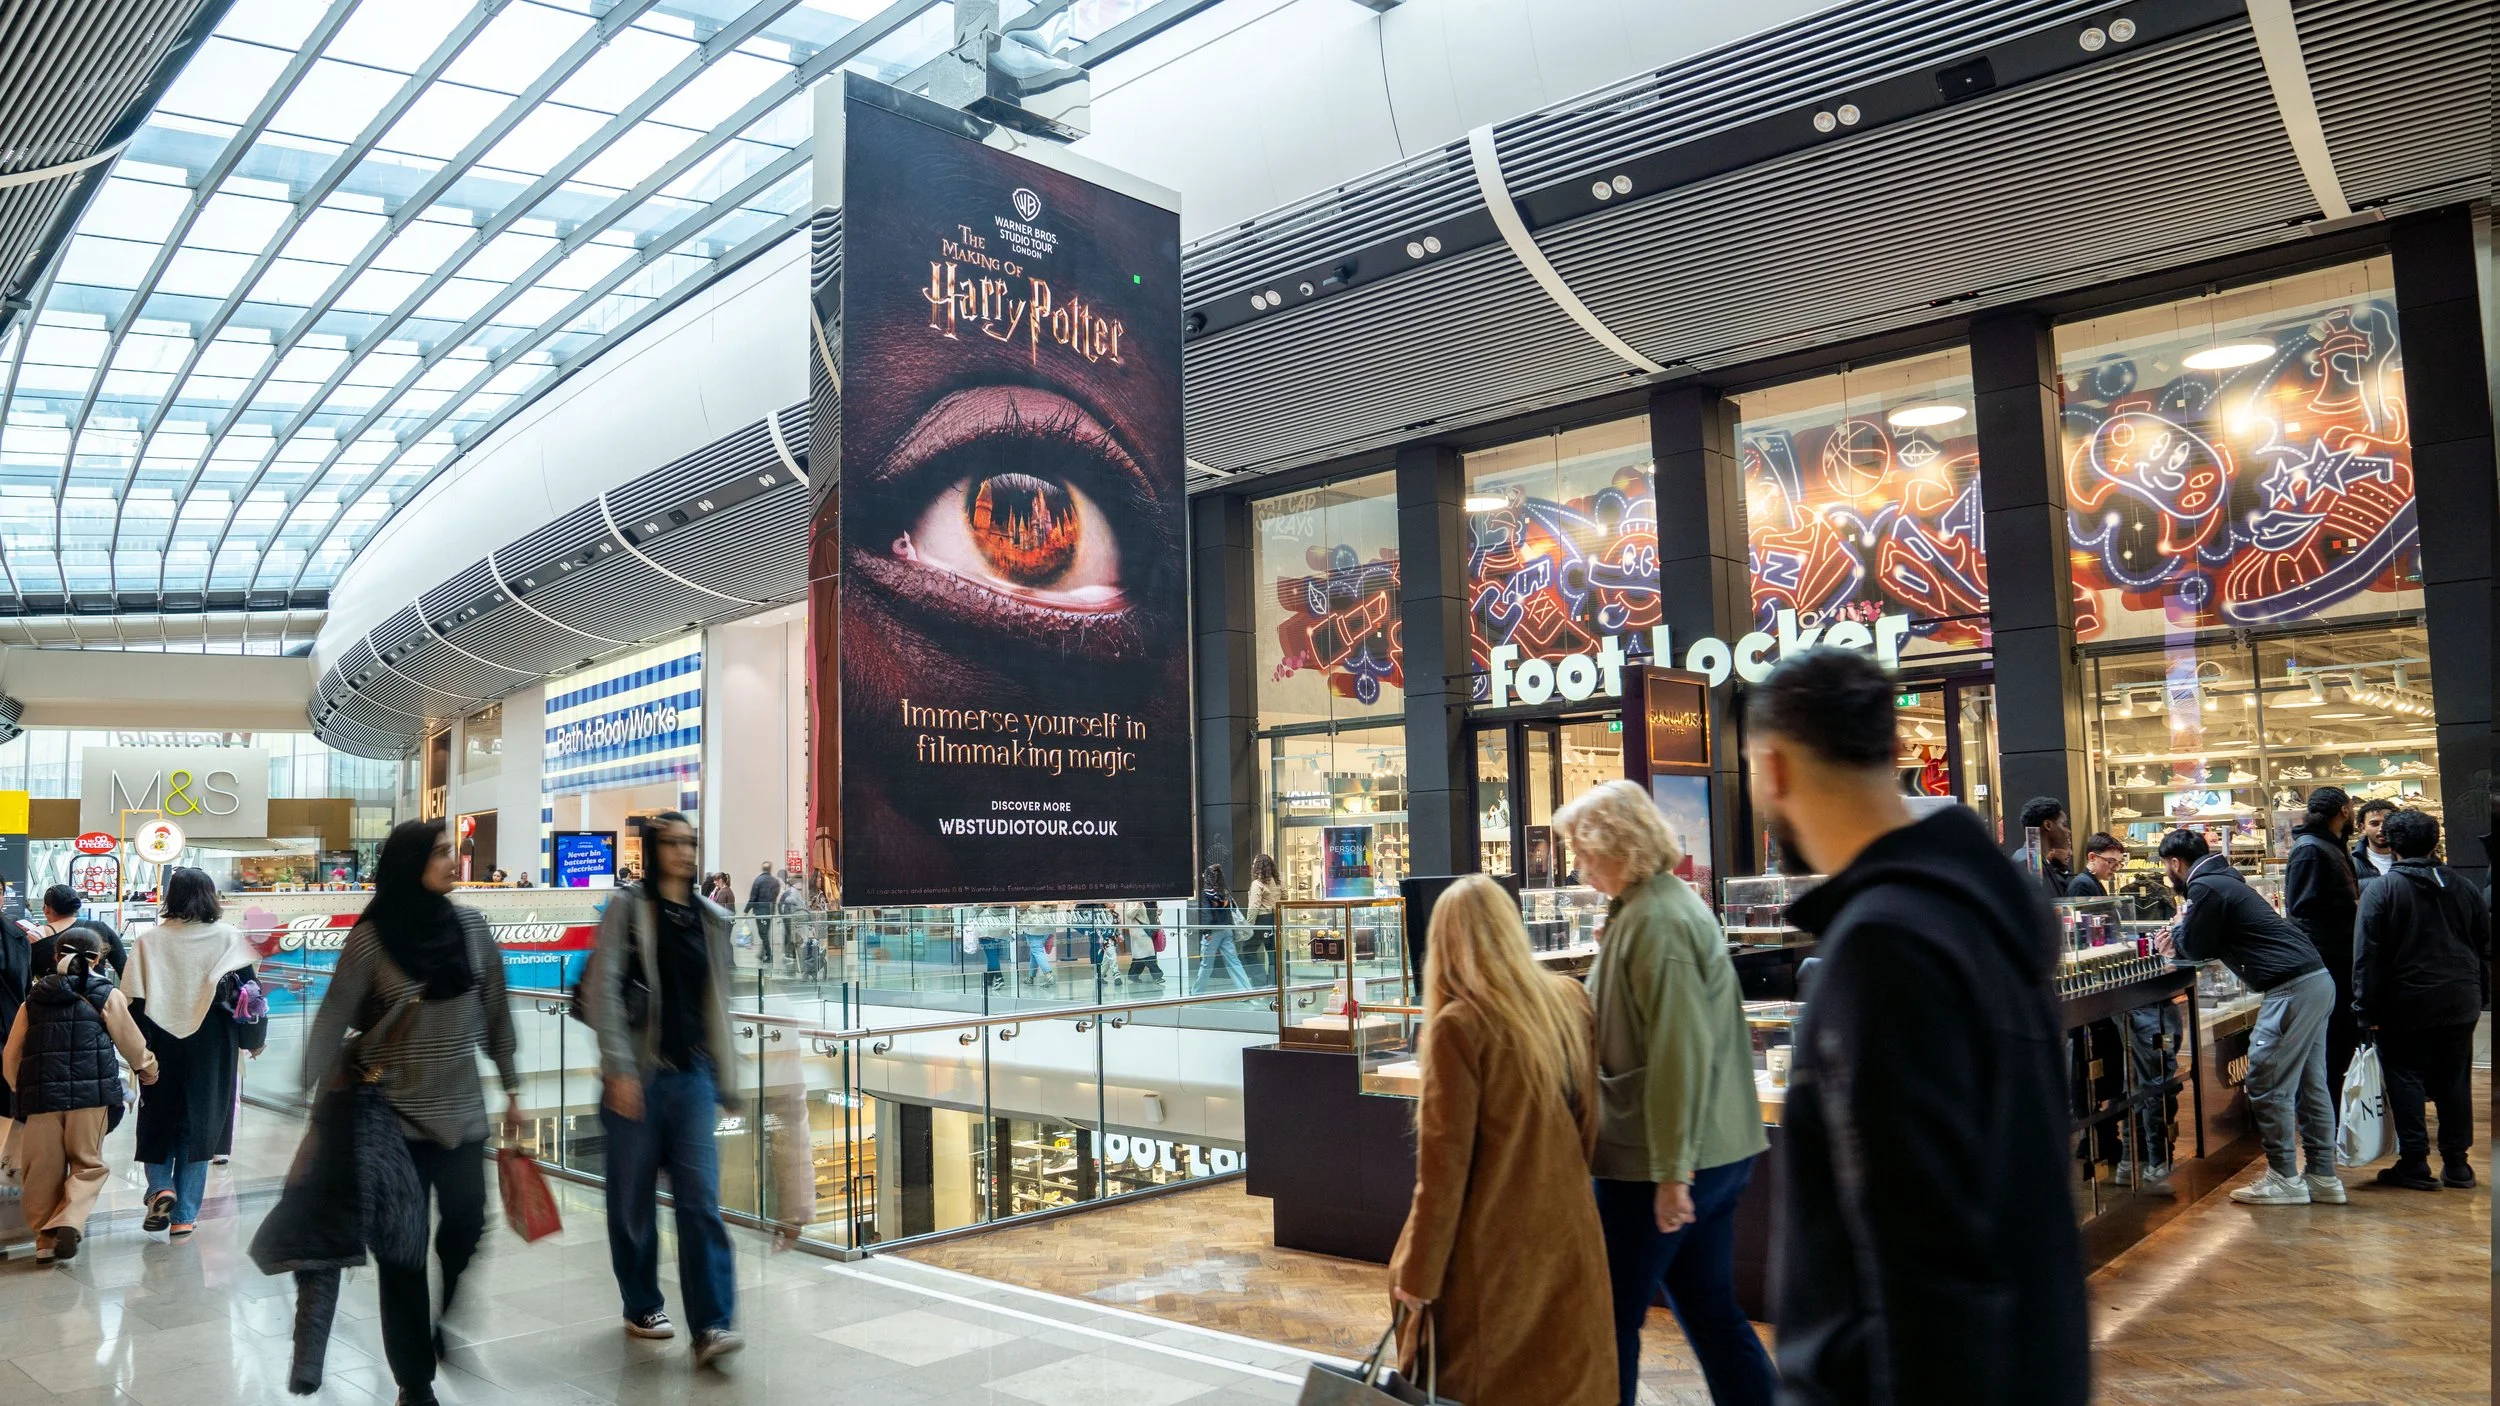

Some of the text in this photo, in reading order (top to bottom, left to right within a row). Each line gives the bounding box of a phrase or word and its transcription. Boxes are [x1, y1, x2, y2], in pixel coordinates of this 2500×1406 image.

[1015, 191, 1039, 219] WB
[994, 215, 1059, 245] WARNER BROS.
[1000, 228, 1053, 254] STUDIO TOUR
[1012, 244, 1042, 260] LONDON
[922, 260, 1125, 366] Harry Potter
[1255, 510, 1314, 537] SPRAYS
[557, 702, 677, 755] Bath & Body Works
[901, 698, 1147, 742] Immerse yourself in
[916, 734, 1137, 777] filmmaking magic
[110, 768, 240, 816] M&S
[427, 785, 447, 820] NEXT
[1286, 790, 1331, 808] OMEN
[991, 800, 1072, 812] DISCOVER MORE
[938, 817, 1119, 837] WBSTUDIOTOUR.CO.UK
[78, 838, 114, 849] Pretzels
[567, 849, 601, 859] Never bin
[1329, 845, 1369, 853] PERSONA
[564, 857, 597, 866] batteries
[567, 864, 604, 874] electricals
[1091, 1131, 1176, 1172] oot
